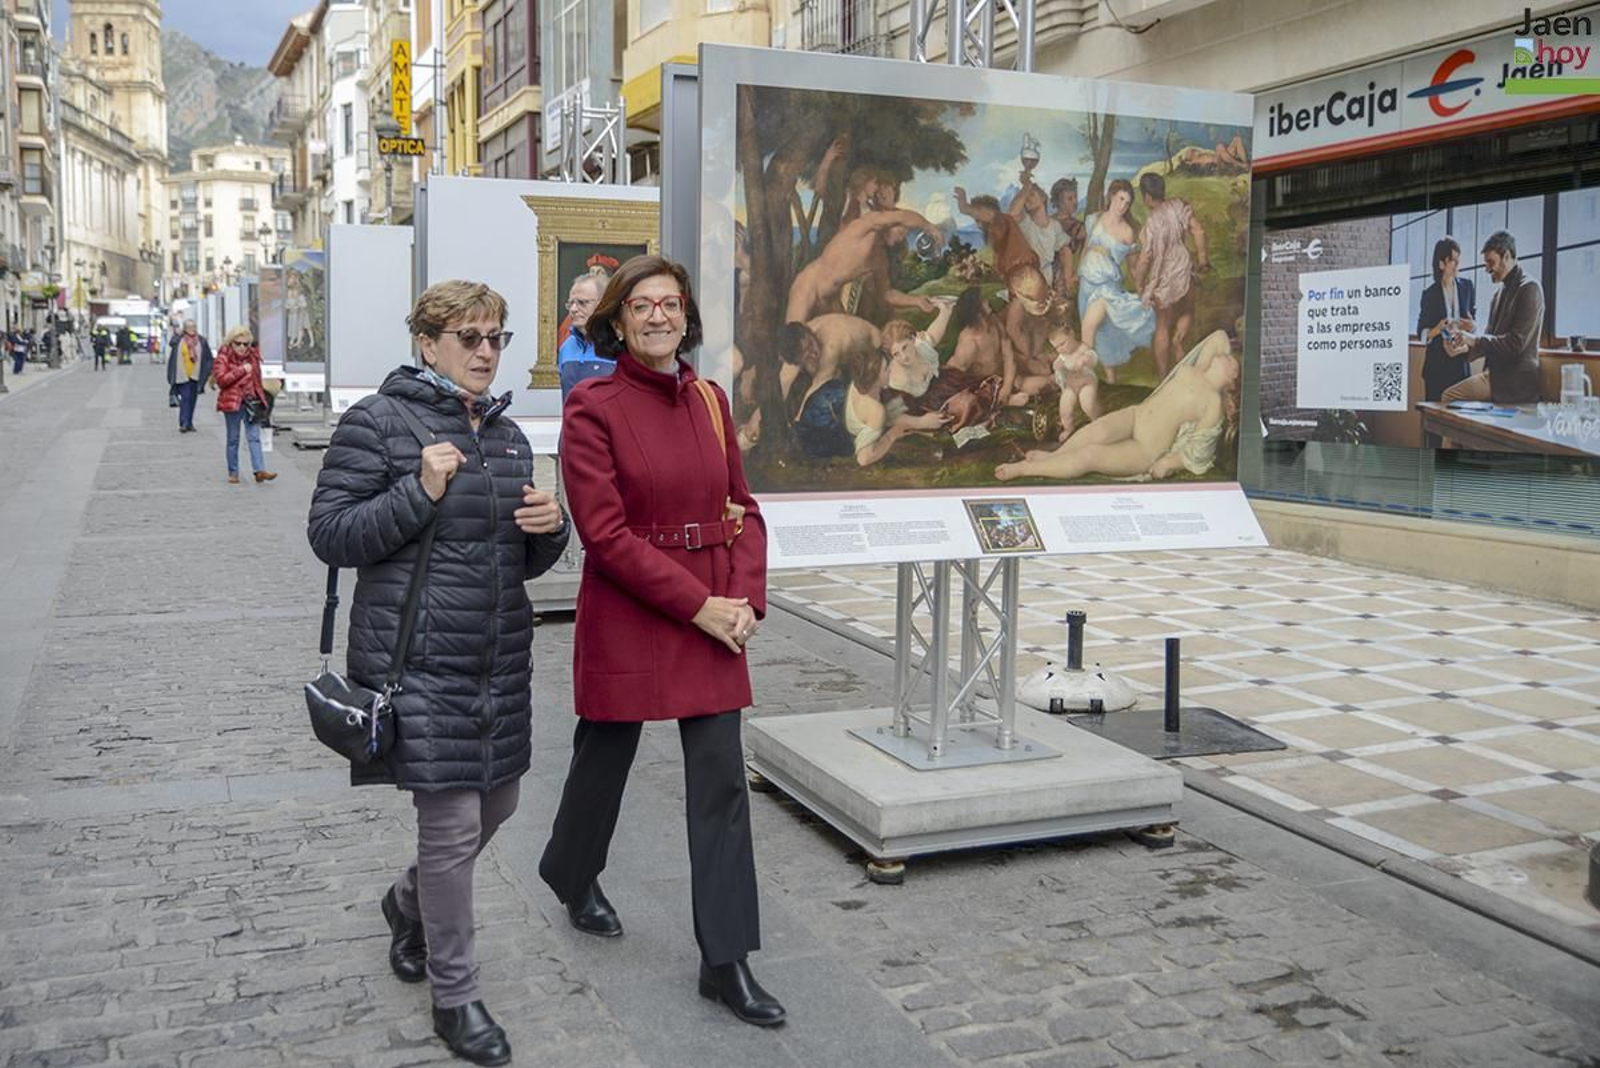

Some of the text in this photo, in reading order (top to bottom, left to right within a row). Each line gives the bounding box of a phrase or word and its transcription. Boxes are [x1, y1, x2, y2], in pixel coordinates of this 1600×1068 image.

[1268, 81, 1398, 138] iberCaja
[379, 138, 425, 155] OPTICA
[1307, 285, 1401, 301] Por fin un banco
[1307, 305, 1360, 319] que trata
[1307, 321, 1391, 334] a las empresas
[1306, 339, 1393, 352] como personas
